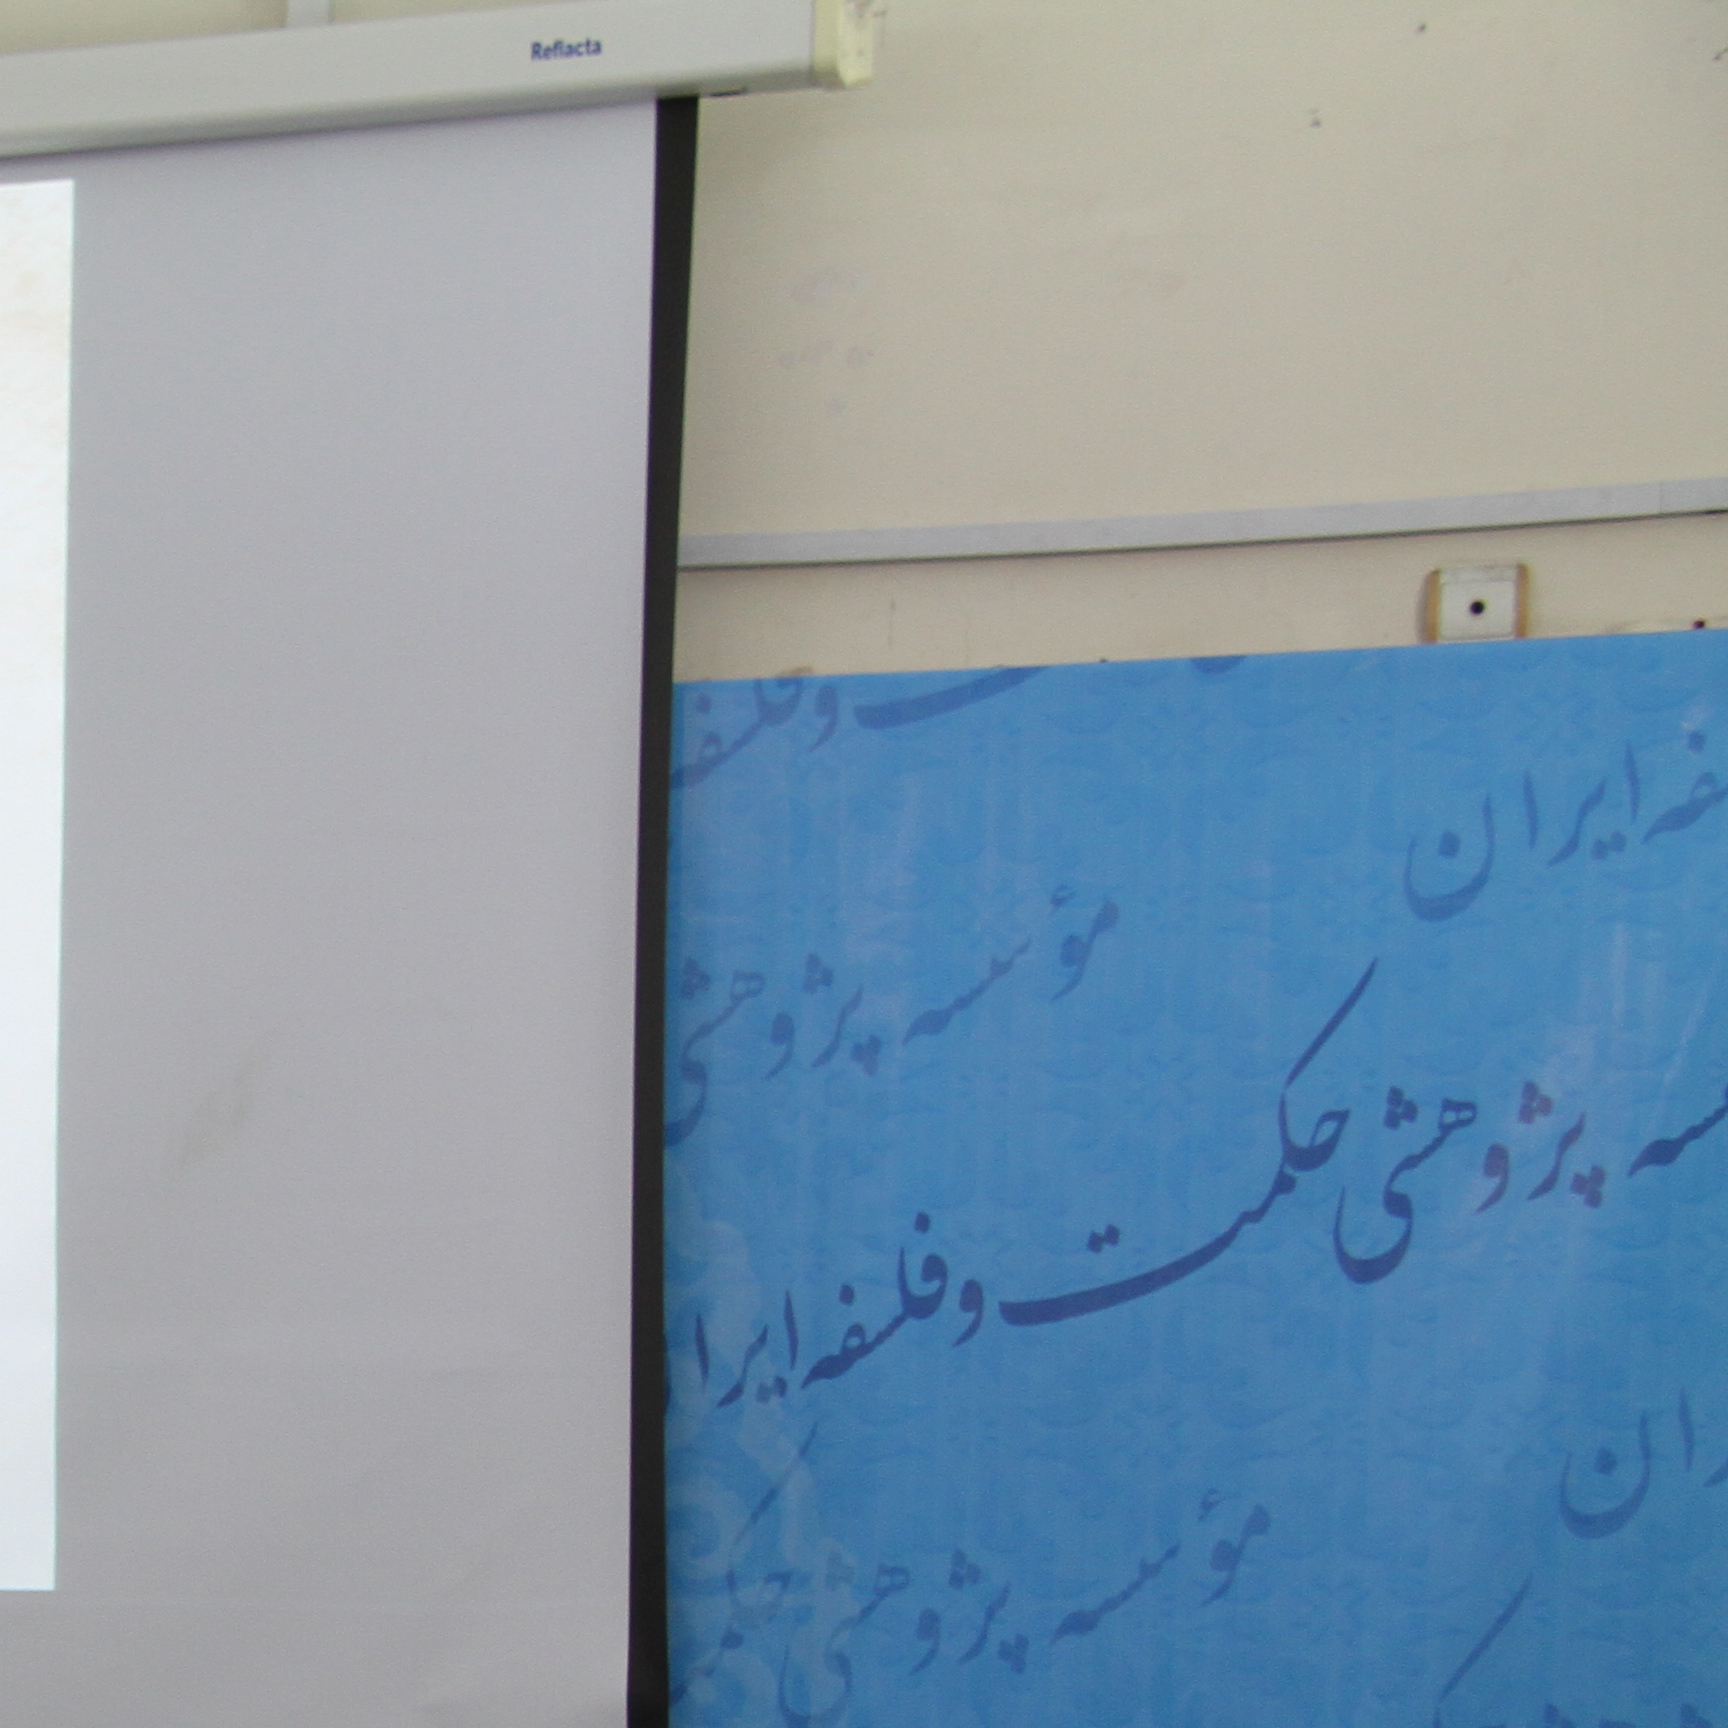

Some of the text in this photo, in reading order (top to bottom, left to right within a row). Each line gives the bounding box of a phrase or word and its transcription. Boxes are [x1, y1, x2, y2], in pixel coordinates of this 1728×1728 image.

[1402, 736, 1642, 923] ایران
[997, 956, 1380, 1328] حکمت
[1332, 1079, 1608, 1284] پژوهشی
[692, 1289, 800, 1411] ایرا
[800, 1210, 950, 1393] فلسفه
[950, 1278, 985, 1348] و
